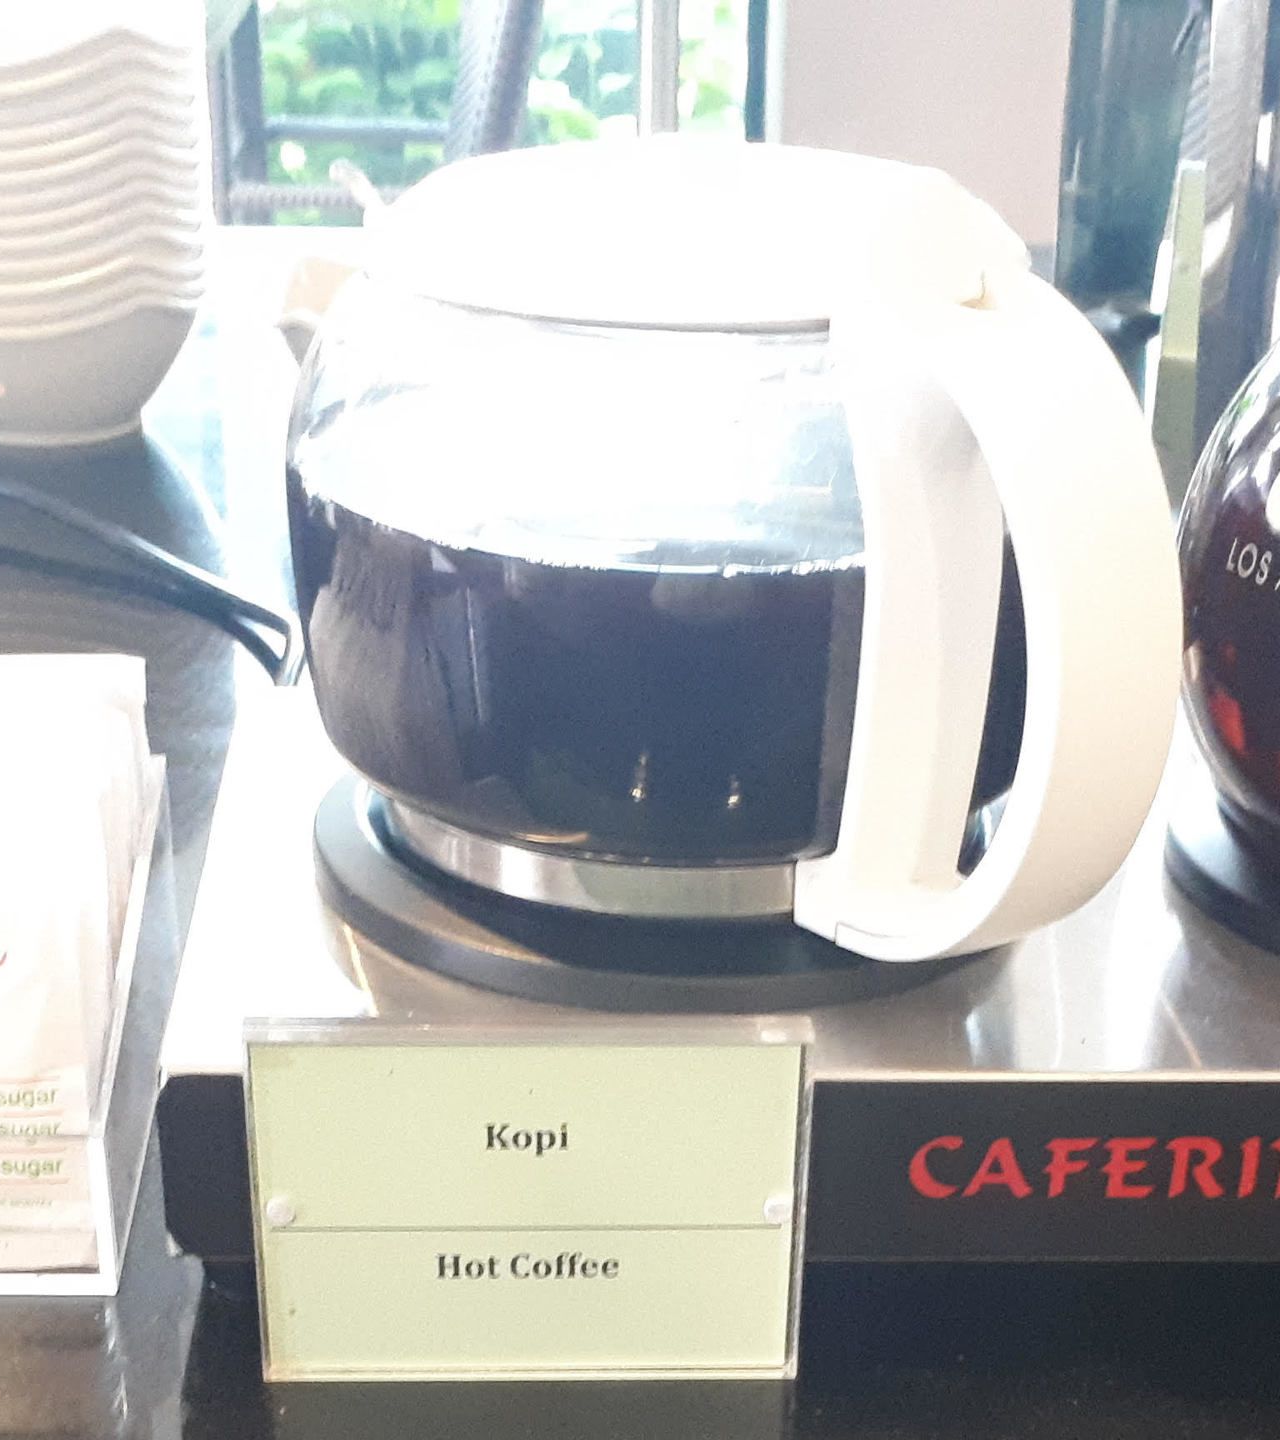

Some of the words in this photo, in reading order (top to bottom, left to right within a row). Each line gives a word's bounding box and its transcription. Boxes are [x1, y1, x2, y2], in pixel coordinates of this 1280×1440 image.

[1225, 537, 1272, 586] LOS
[486, 1122, 568, 1157] Kopi
[0, 1156, 64, 1178] sugar
[436, 1252, 500, 1280] Hot
[509, 1250, 619, 1280] Coffee
